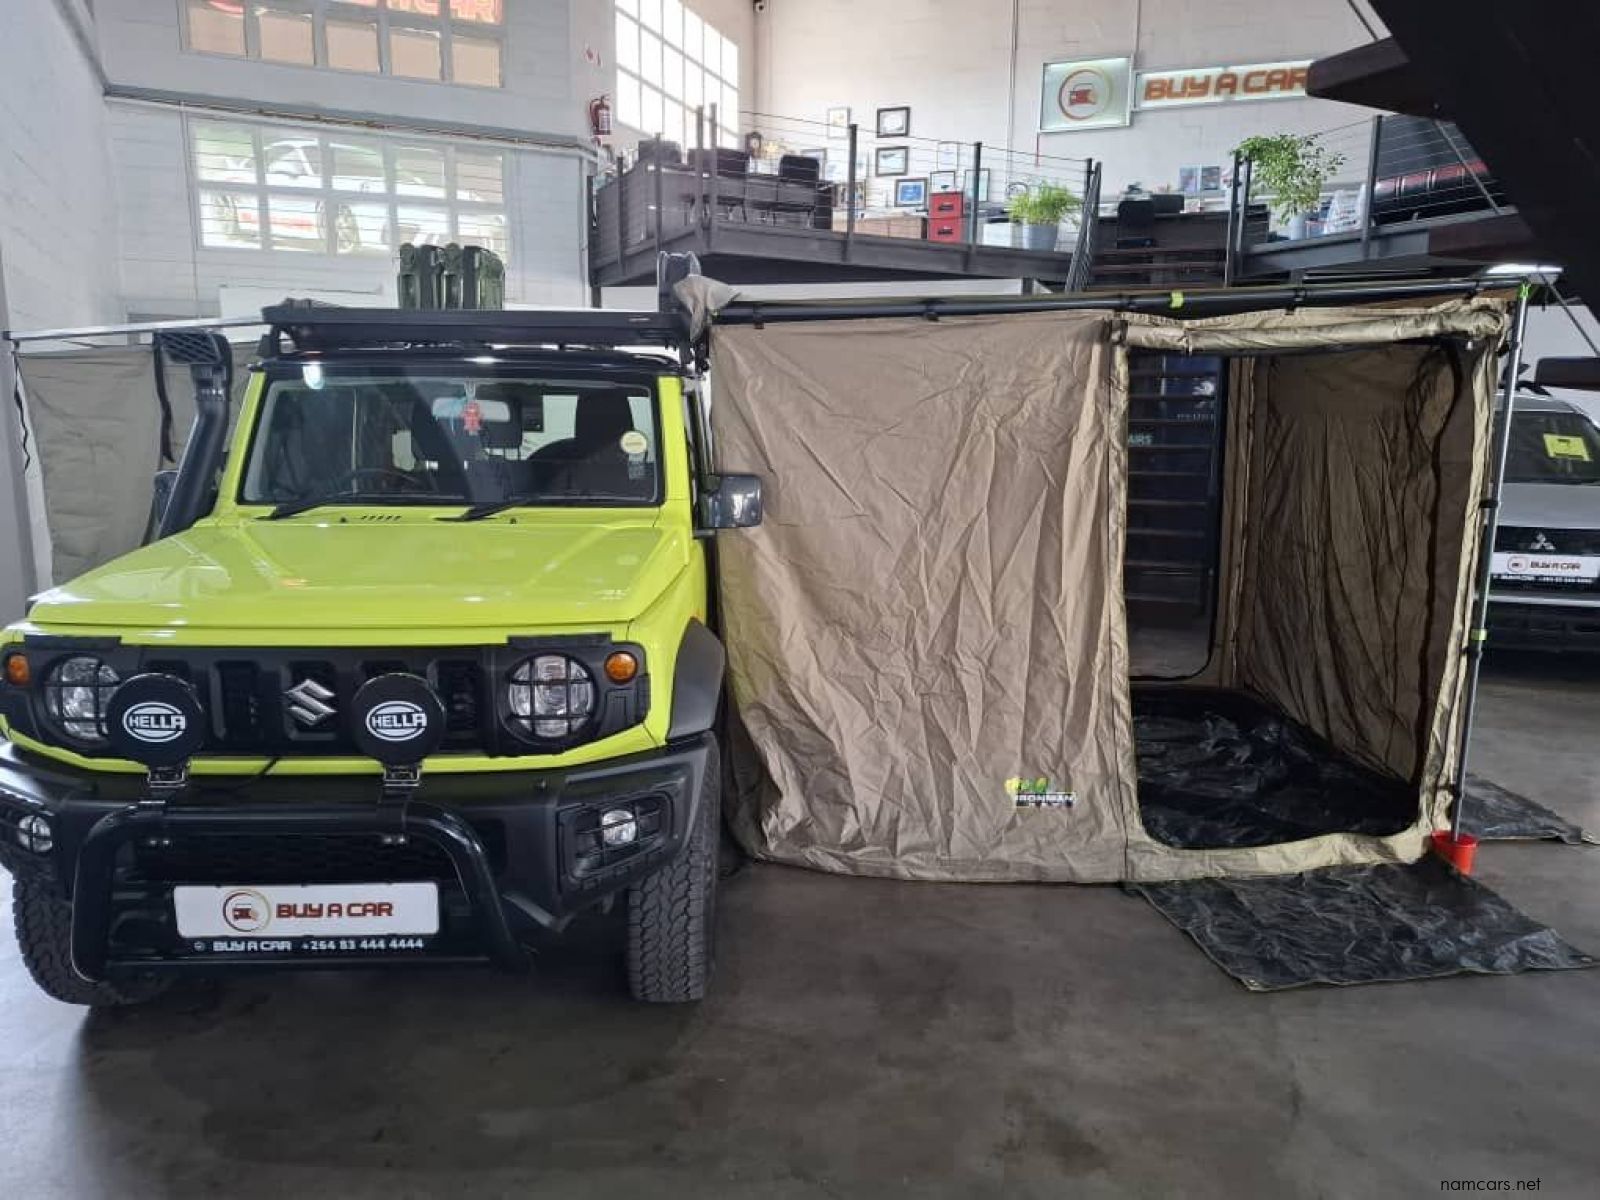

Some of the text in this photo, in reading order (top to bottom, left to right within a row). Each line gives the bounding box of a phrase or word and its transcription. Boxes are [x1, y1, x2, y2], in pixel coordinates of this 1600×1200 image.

[1144, 75, 1208, 100] BUY
[1214, 72, 1238, 95] A
[129, 714, 186, 730] HELLA
[371, 713, 427, 728] HELLA
[275, 902, 393, 918] BUY A CAR
[213, 941, 245, 952] BUY
[247, 941, 258, 952] A
[260, 940, 292, 952] CAR
[360, 939, 385, 950] 444
[388, 938, 424, 949] 4444
